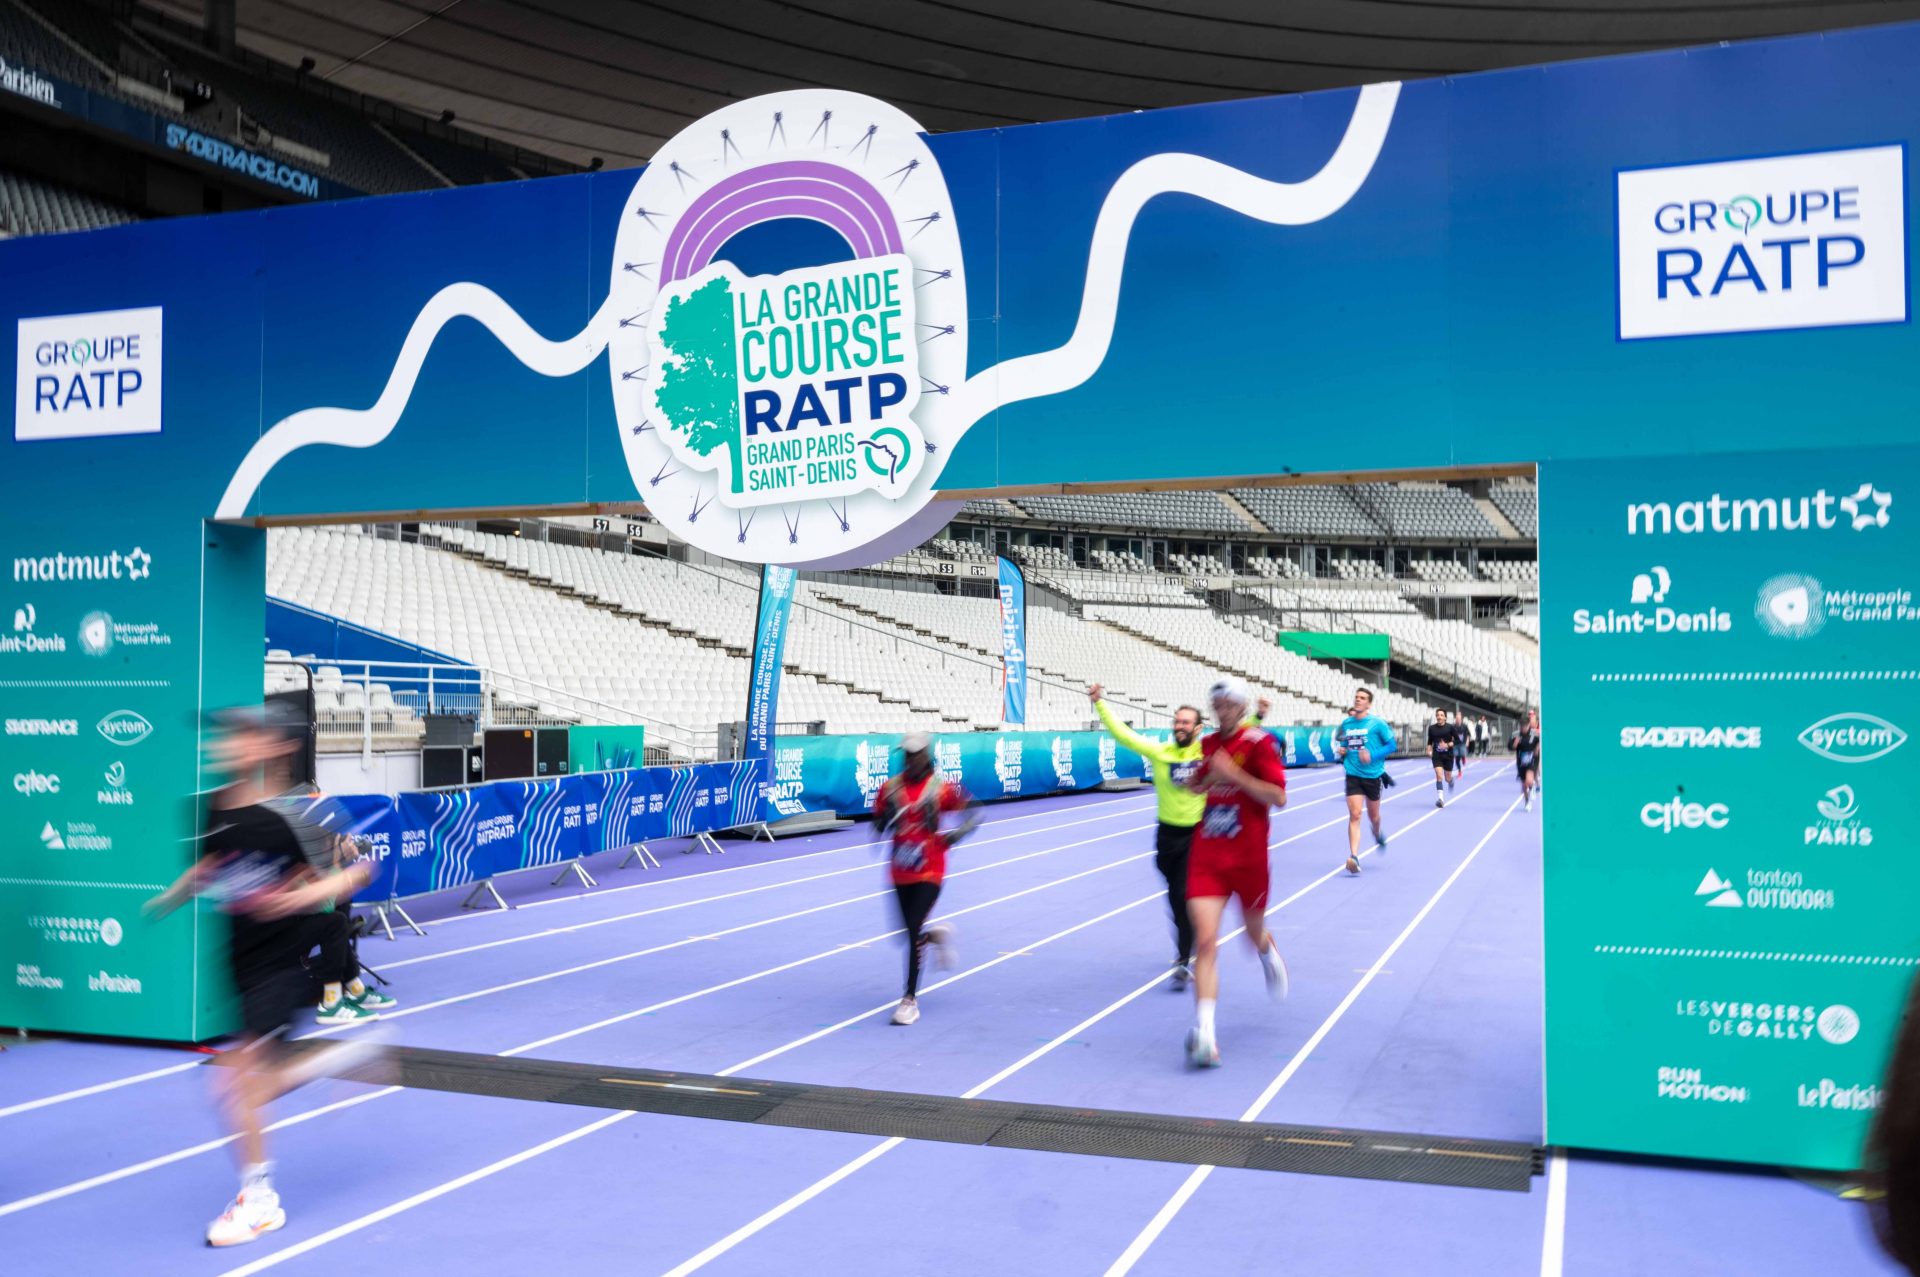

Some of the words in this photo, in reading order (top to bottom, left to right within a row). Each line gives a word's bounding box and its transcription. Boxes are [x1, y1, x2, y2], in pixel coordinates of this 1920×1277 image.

[1654, 185, 1860, 234] GROUPE
[1657, 233, 1865, 302] RATP
[740, 289, 775, 328] LA
[784, 268, 901, 322] GRANDE
[36, 334, 140, 367] GROUPE
[743, 309, 904, 383] COURSE
[35, 368, 142, 414] RATP
[744, 372, 908, 436] RATP
[746, 437, 802, 466] GRAND
[806, 432, 855, 458] PARIS
[749, 458, 857, 491] SAINT-DENIS
[1627, 489, 1836, 535] matmut
[14, 550, 122, 582] matmut
[972, 567, 986, 576] R14
[1825, 587, 1912, 608] Métropole
[1573, 606, 1732, 633] Saint-Denis
[1842, 604, 1892, 622] Grand
[1897, 604, 1920, 622] Par
[0, 632, 66, 652] int-Denis
[762, 671, 772, 700] PARIS
[103, 719, 146, 737] syctom
[1620, 726, 1761, 748] STADEFRANCE
[1811, 725, 1893, 751] syctom
[97, 790, 134, 805] PARIS
[1804, 826, 1873, 846] PARIS
[402, 841, 426, 859] RATP
[1747, 867, 1803, 888] tonton
[1657, 1066, 1701, 1083] RUN
[1657, 1082, 1746, 1102] MOTION
